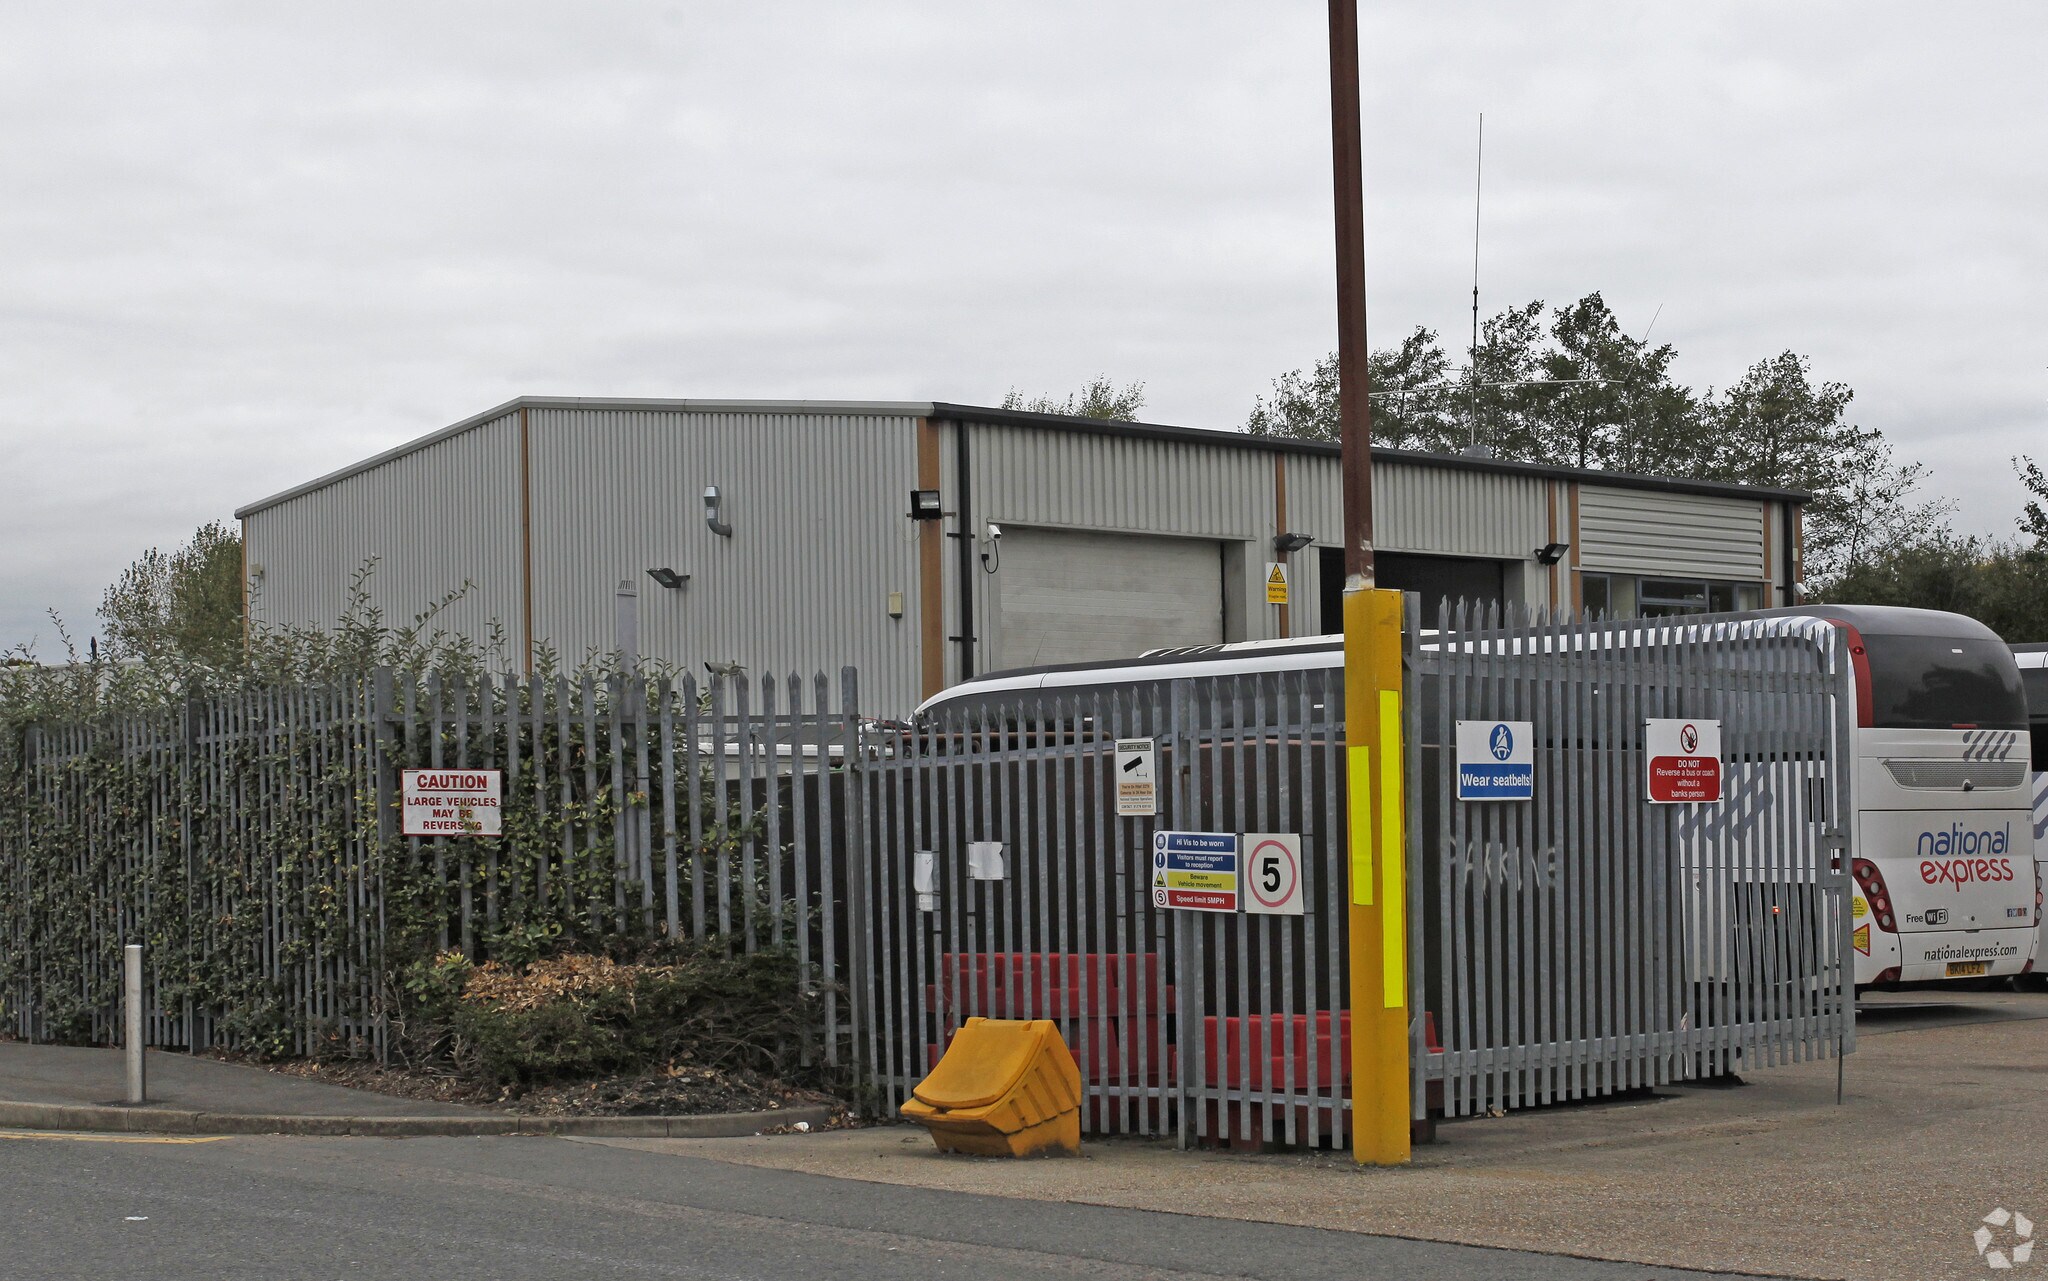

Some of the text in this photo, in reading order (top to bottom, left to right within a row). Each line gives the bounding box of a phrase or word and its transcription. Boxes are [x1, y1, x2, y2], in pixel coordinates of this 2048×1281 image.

[1678, 760, 1700, 768] DO NOT
[1656, 768, 1680, 776] Reverse
[417, 774, 487, 788] CAUTION
[1461, 773, 1532, 786] Wear seatbelts!
[1677, 779, 1695, 787] without
[1671, 790, 1705, 798] banks person
[408, 797, 497, 807] LARGE VEHICLES
[432, 809, 473, 818] MAY BE
[423, 821, 483, 831] REVERSG
[1917, 821, 2010, 855] national
[1263, 857, 1281, 892] 5
[1920, 858, 2014, 892] express
[1157, 891, 1164, 901] 5
[1176, 895, 1193, 903] Speed
[1906, 914, 1924, 923] Free
[1924, 945, 2018, 961] nationalexpress.com
